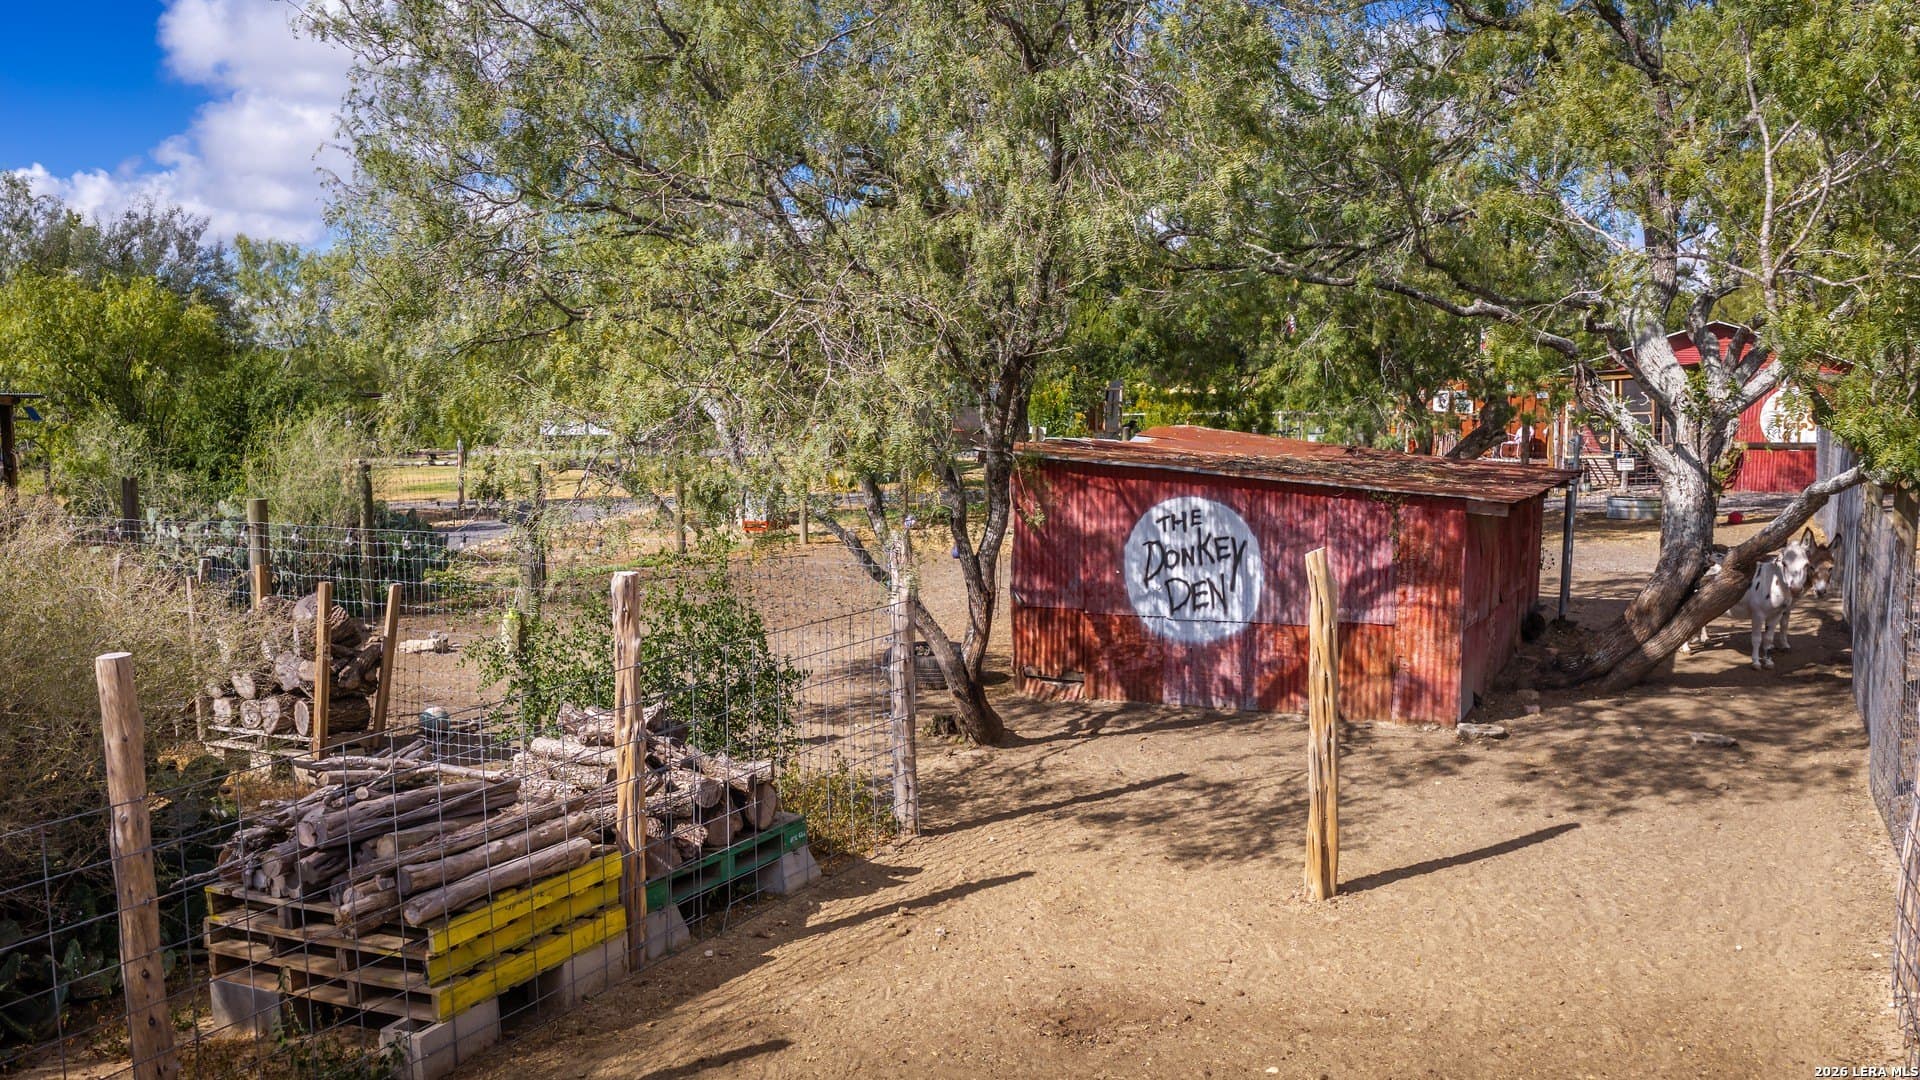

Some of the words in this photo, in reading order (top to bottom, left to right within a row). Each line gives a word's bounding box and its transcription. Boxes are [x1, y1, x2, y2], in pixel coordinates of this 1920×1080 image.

[1155, 509, 1203, 533] THE
[1142, 527, 1248, 592] DONKEY
[1164, 572, 1229, 617] DEN
